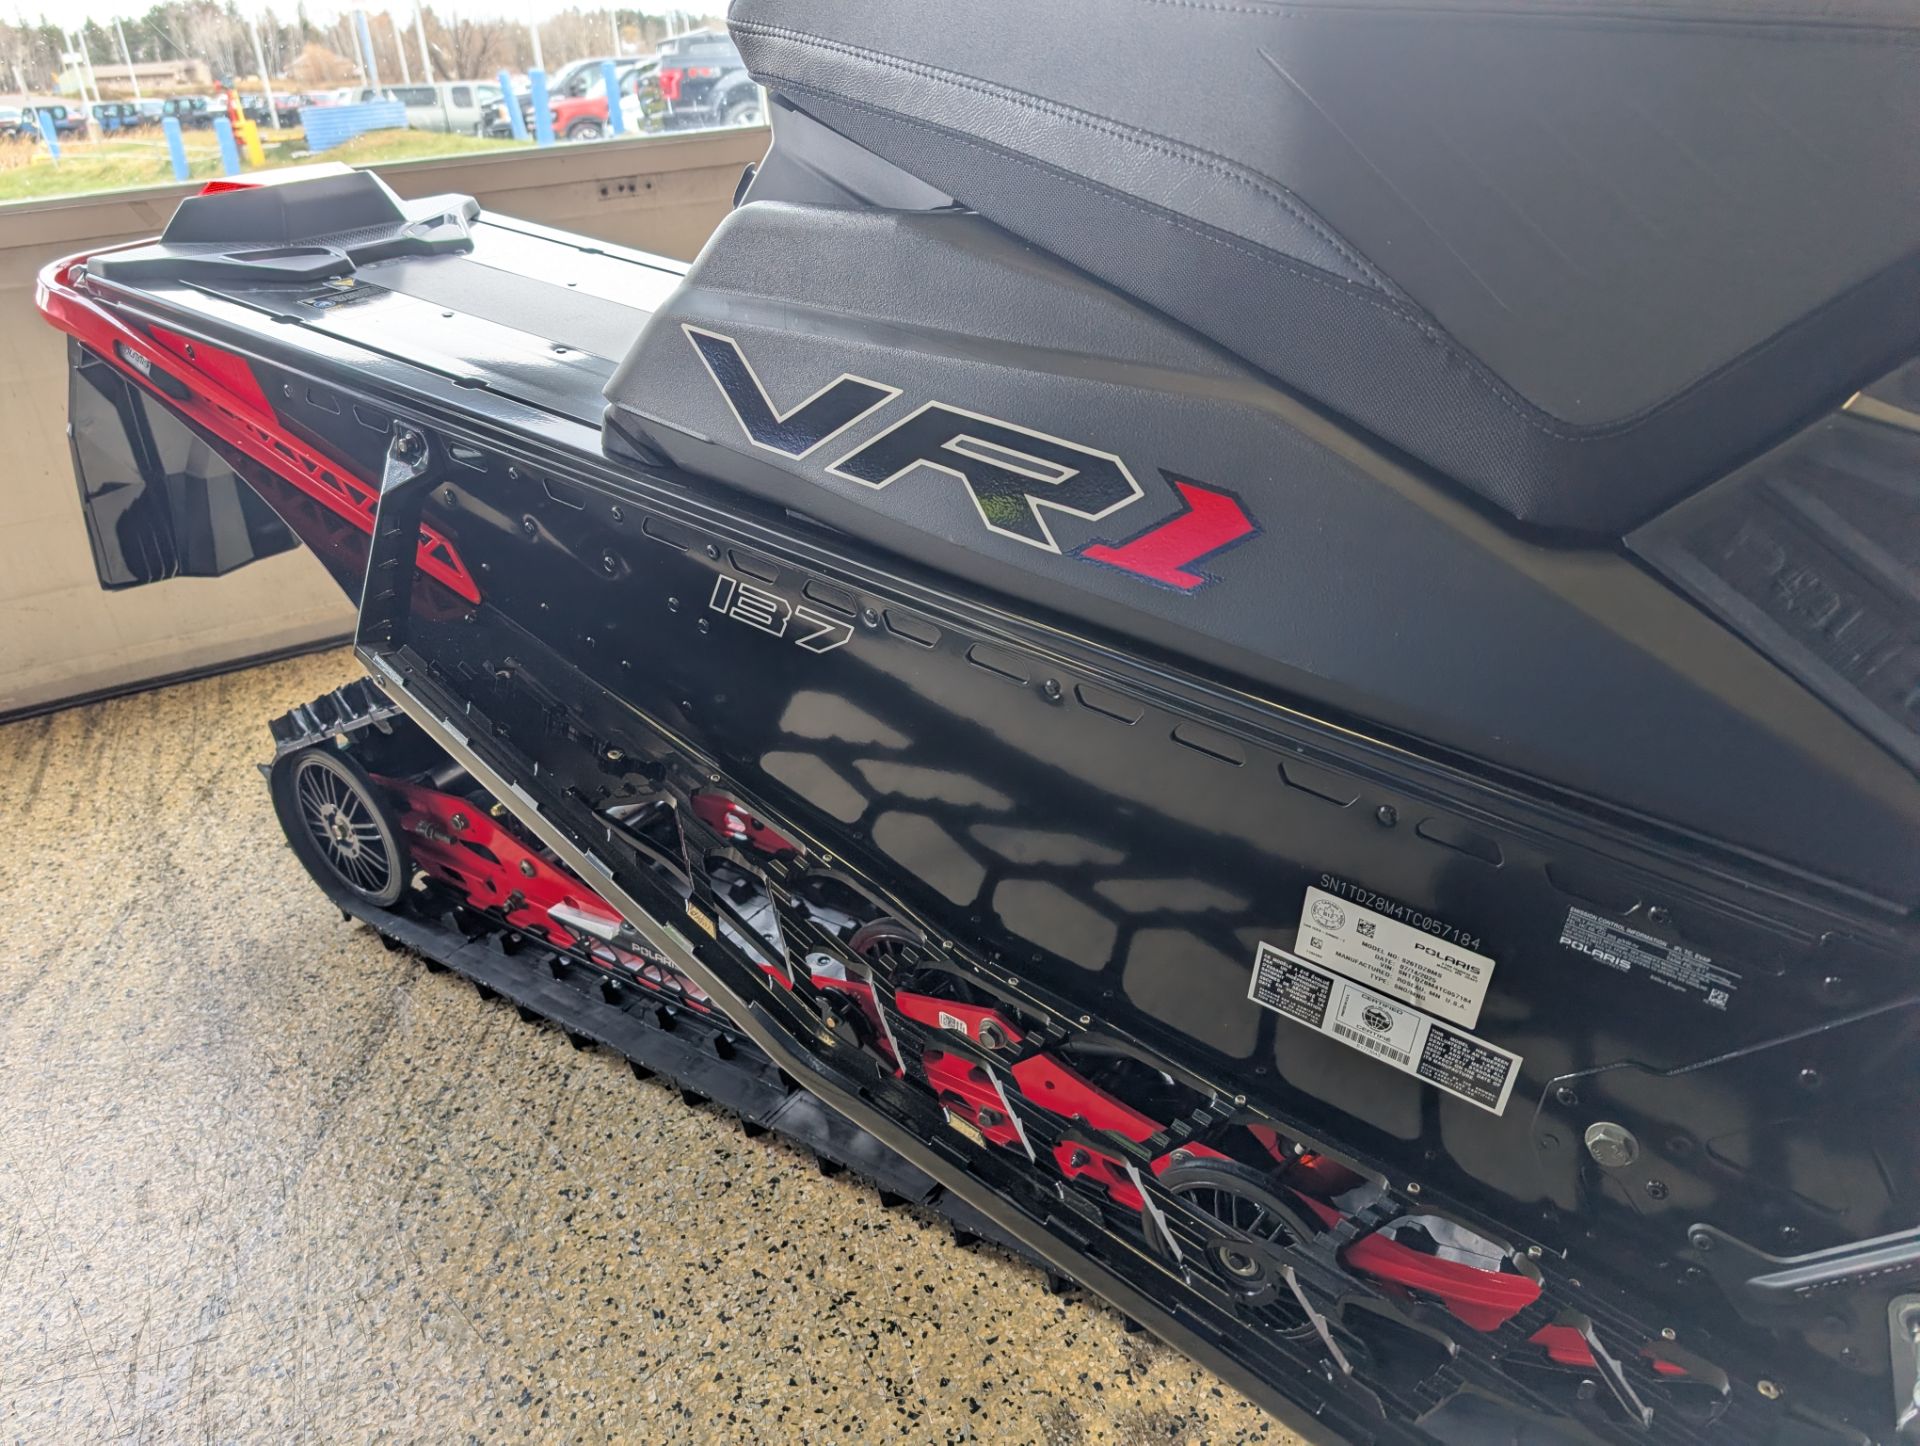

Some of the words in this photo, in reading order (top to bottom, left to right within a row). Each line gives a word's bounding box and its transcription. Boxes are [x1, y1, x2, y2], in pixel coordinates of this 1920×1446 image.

[682, 323, 1263, 595] VR1
[709, 574, 855, 655] 137
[1320, 874, 1480, 950] SN1TDZ8M4TC057184
[1570, 906, 1597, 920] EMISSION
[1598, 917, 1625, 931] CONTROL
[1626, 928, 1667, 947] INFORMATION
[632, 943, 679, 969] POLARI
[1362, 941, 1384, 954] MODEL
[1387, 952, 1399, 960] NO:
[1375, 954, 1395, 966] DATE:
[1414, 942, 1481, 975] POLARIS
[1559, 936, 1631, 969] POLARIS
[1295, 972, 1328, 989] LABORATOIRE
[1336, 951, 1392, 978] MANUFACTURED:
[1396, 976, 1426, 993] ROSEAU,
[1429, 990, 1440, 999] MN
[1370, 973, 1390, 985] TYPE:
[1380, 962, 1394, 971] VIN:
[1361, 993, 1403, 1015] CERTIFIED
[1356, 1024, 1390, 1042] CERTIFIÉ
[1430, 1033, 1461, 1049] EVALUATED
[1427, 1042, 1445, 1052] ATORY
[1448, 1051, 1460, 1059] AND
[1471, 1062, 1490, 1072] MEETS
[1429, 1038, 1444, 1047] DENT
[1450, 1047, 1475, 1060] TESTING
[1450, 1037, 1468, 1047] MODEL
[1475, 1048, 1486, 1056] HAS
[1493, 1056, 1509, 1065] BEEN
[1432, 1054, 1452, 1065] EFFECT
[1476, 1074, 1491, 1083] DATE
[1444, 1054, 1465, 1066] SAFETY
[1468, 1065, 1502, 1082] STANDARDS
